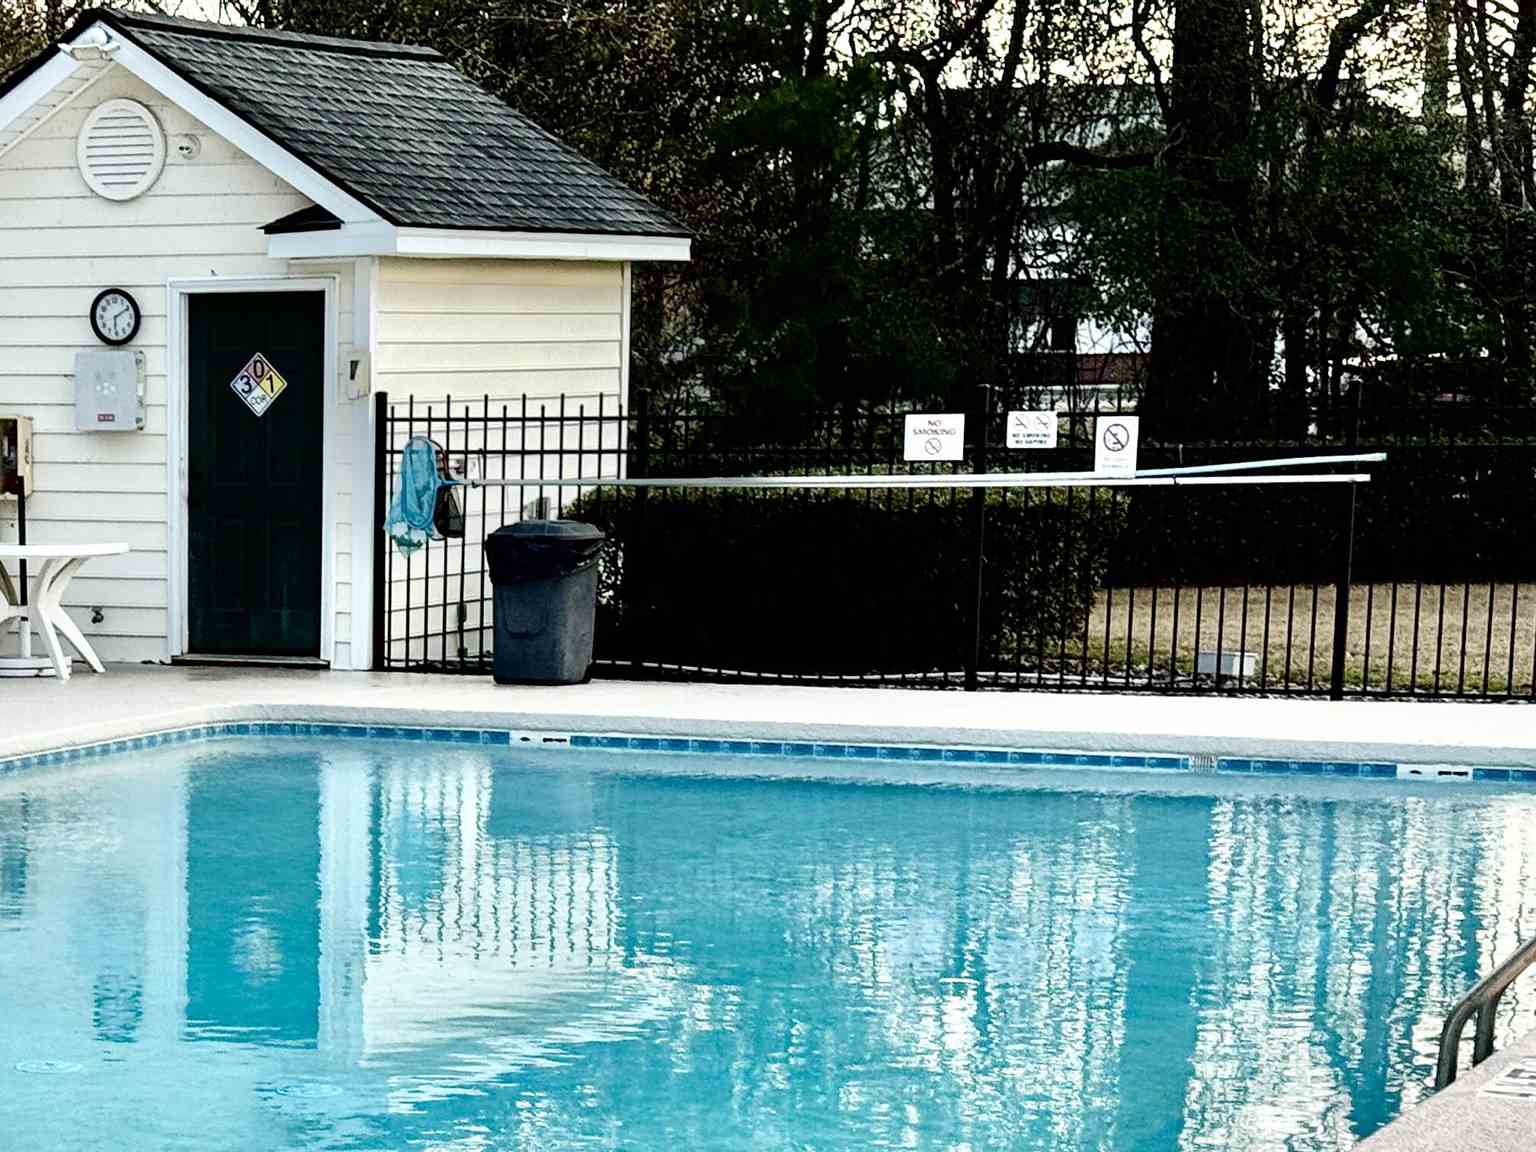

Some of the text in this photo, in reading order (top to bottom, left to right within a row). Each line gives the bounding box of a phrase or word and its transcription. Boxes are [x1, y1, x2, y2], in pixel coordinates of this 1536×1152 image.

[253, 359, 264, 378] 0
[240, 375, 253, 394] 3
[265, 373, 274, 394] 1
